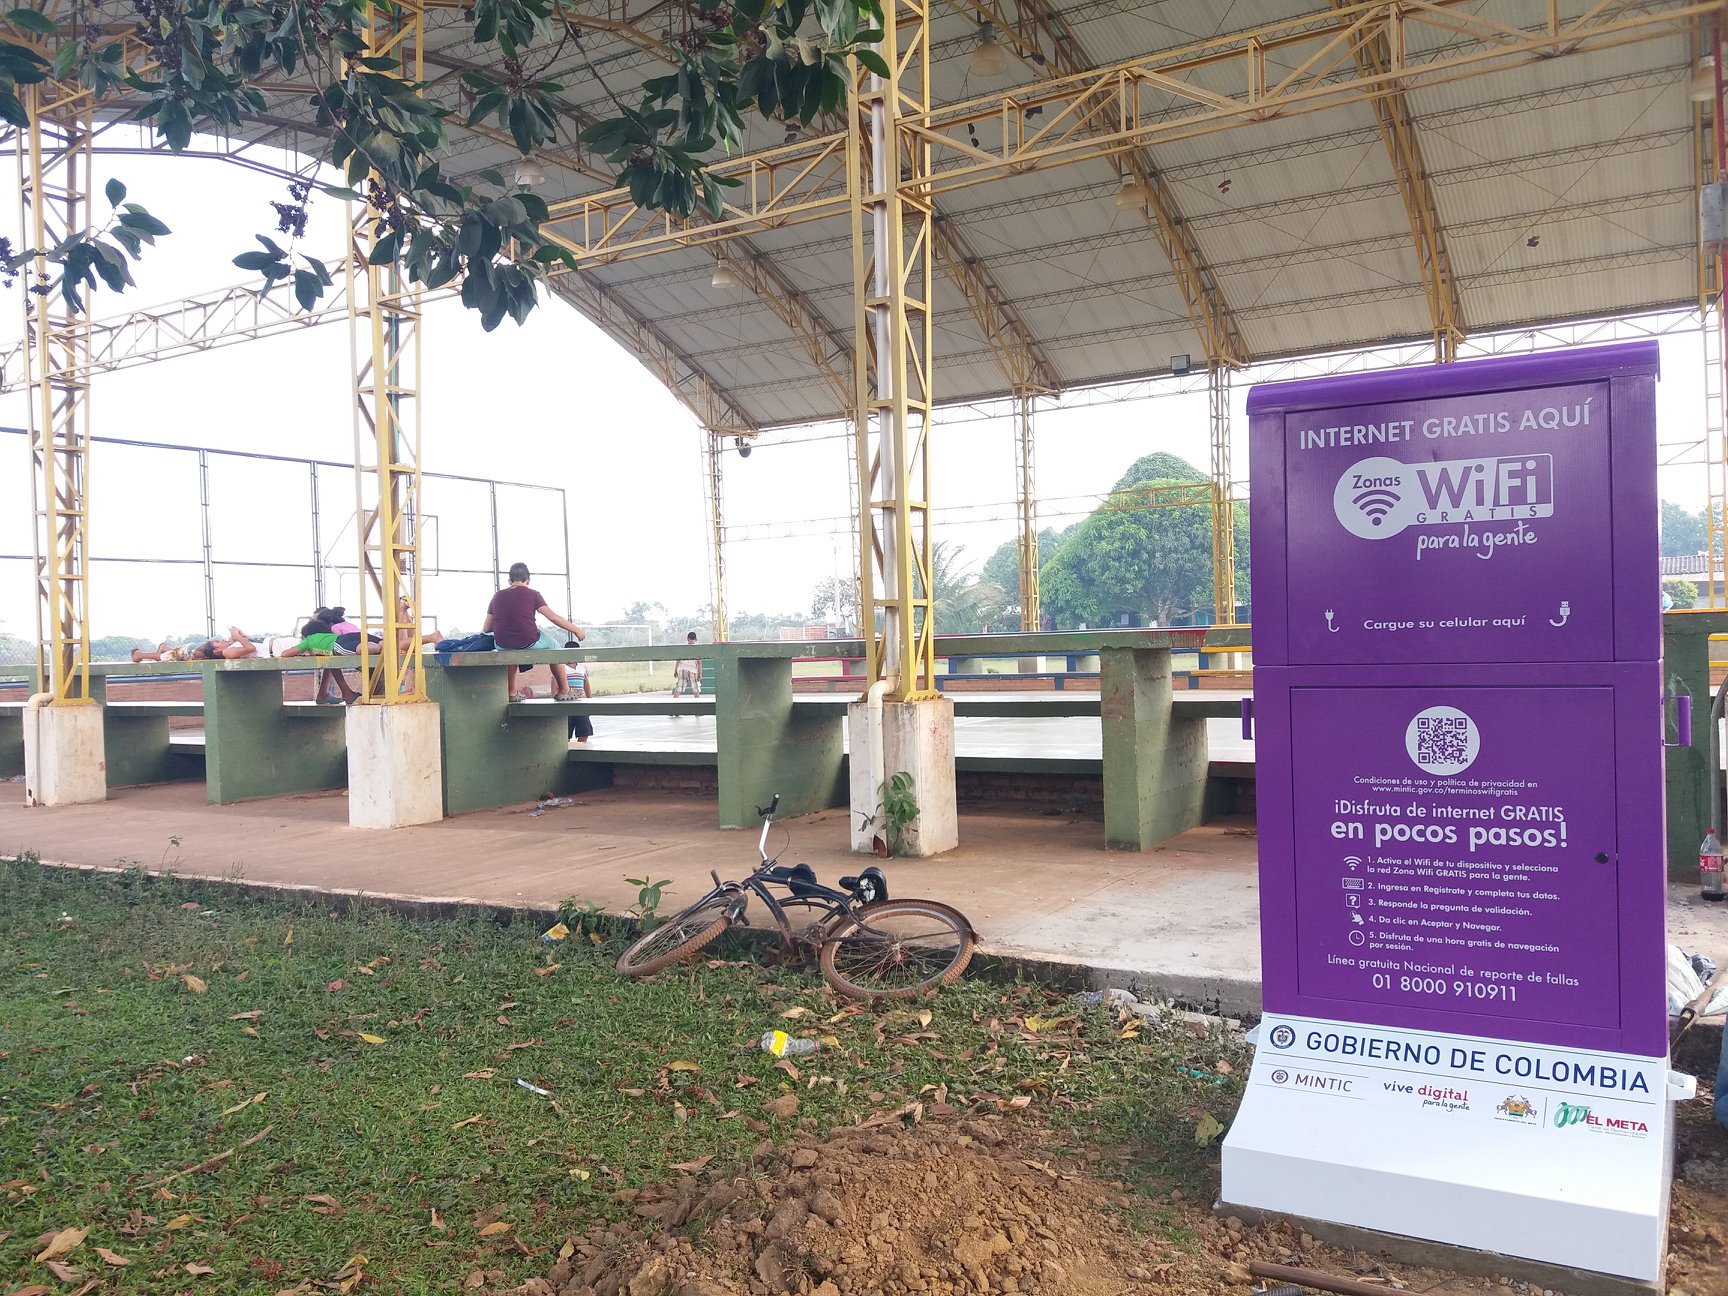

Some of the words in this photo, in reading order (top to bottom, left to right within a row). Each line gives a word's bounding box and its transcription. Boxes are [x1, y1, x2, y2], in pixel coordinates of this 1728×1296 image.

[1299, 421, 1415, 450] INTERNET
[1423, 412, 1510, 438] GRATIS
[1519, 397, 1595, 431] AQUÍ
[1352, 473, 1402, 489] Zonas
[1415, 460, 1537, 511] WiFi
[1416, 505, 1538, 525] GRATIS
[1415, 534, 1460, 561] para
[1463, 525, 1482, 548] la
[1477, 521, 1538, 560] gente
[1363, 619, 1415, 632] Cargue
[1418, 620, 1434, 629] su
[1439, 616, 1489, 628] celular
[1492, 614, 1526, 629] aquí
[1353, 776, 1400, 785] Condiciones
[1402, 777, 1412, 785] de
[1437, 778, 1467, 788] política
[1468, 779, 1479, 787] de
[1481, 779, 1525, 789] privacidad
[1372, 785, 1518, 797] www.mintic.gov.co/terminoswifigratis
[1406, 801, 1427, 817] de
[1432, 802, 1495, 820] internet
[1500, 805, 1564, 822] GRATIS
[1331, 821, 1364, 839] en
[1375, 823, 1458, 848] pocos
[1469, 822, 1568, 852] pasos!
[1367, 856, 1375, 864] 1.
[1377, 857, 1402, 865] Activa
[1404, 857, 1412, 866] el
[1414, 858, 1431, 867] Wifi
[1432, 859, 1443, 867] de
[1457, 860, 1503, 870] dispositivo
[1512, 863, 1558, 872] selecciona
[1377, 866, 1391, 874] red
[1393, 867, 1414, 875] Zona
[1416, 868, 1434, 876] Wifi
[1436, 869, 1467, 877] GRATIS
[1469, 872, 1490, 880] para
[1492, 871, 1500, 879] la
[1503, 873, 1530, 882] gente.
[1378, 883, 1409, 892] Ingresa
[1424, 885, 1465, 895] Regístrate
[1475, 888, 1514, 898] completa
[1533, 891, 1560, 900] datos.
[1378, 899, 1418, 909] Responde
[1420, 901, 1428, 909] la
[1431, 904, 1469, 913] pregunta
[1471, 904, 1482, 913] de
[1485, 905, 1532, 916] validación.
[1369, 915, 1376, 923] 4.
[1379, 916, 1391, 924] Da
[1393, 917, 1406, 925] clic
[1421, 919, 1452, 929] Aceptar
[1455, 922, 1460, 930] y
[1463, 922, 1502, 933] Navegar.
[1369, 931, 1377, 939] 5.
[1379, 932, 1412, 941] Disfruta
[1445, 937, 1465, 945] hora
[1467, 939, 1492, 948] gratis
[1508, 943, 1559, 952] navegación
[1386, 942, 1413, 951] sesión.
[1328, 954, 1355, 965] Línea
[1359, 956, 1400, 970] gratuita
[1404, 961, 1455, 975] Nacional
[1459, 965, 1474, 977] de
[1480, 968, 1523, 982] reporte
[1527, 971, 1542, 982] de
[1546, 972, 1579, 987] fallas
[1372, 974, 1391, 989] 01
[1400, 976, 1447, 994] 8000
[1453, 981, 1517, 1001] 910911
[1306, 1031, 1441, 1065] GOBIERNO
[1450, 1049, 1485, 1072] DE
[1495, 1054, 1650, 1093] COLOMBIA
[1295, 1073, 1353, 1092] MINTIC
[1384, 1081, 1413, 1093] vive
[1418, 1085, 1468, 1101] digital
[1422, 1099, 1440, 1108] para
[1441, 1099, 1447, 1107] la
[1446, 1102, 1470, 1112] gente
[1586, 1114, 1603, 1126] EL
[1606, 1118, 1648, 1132] META
